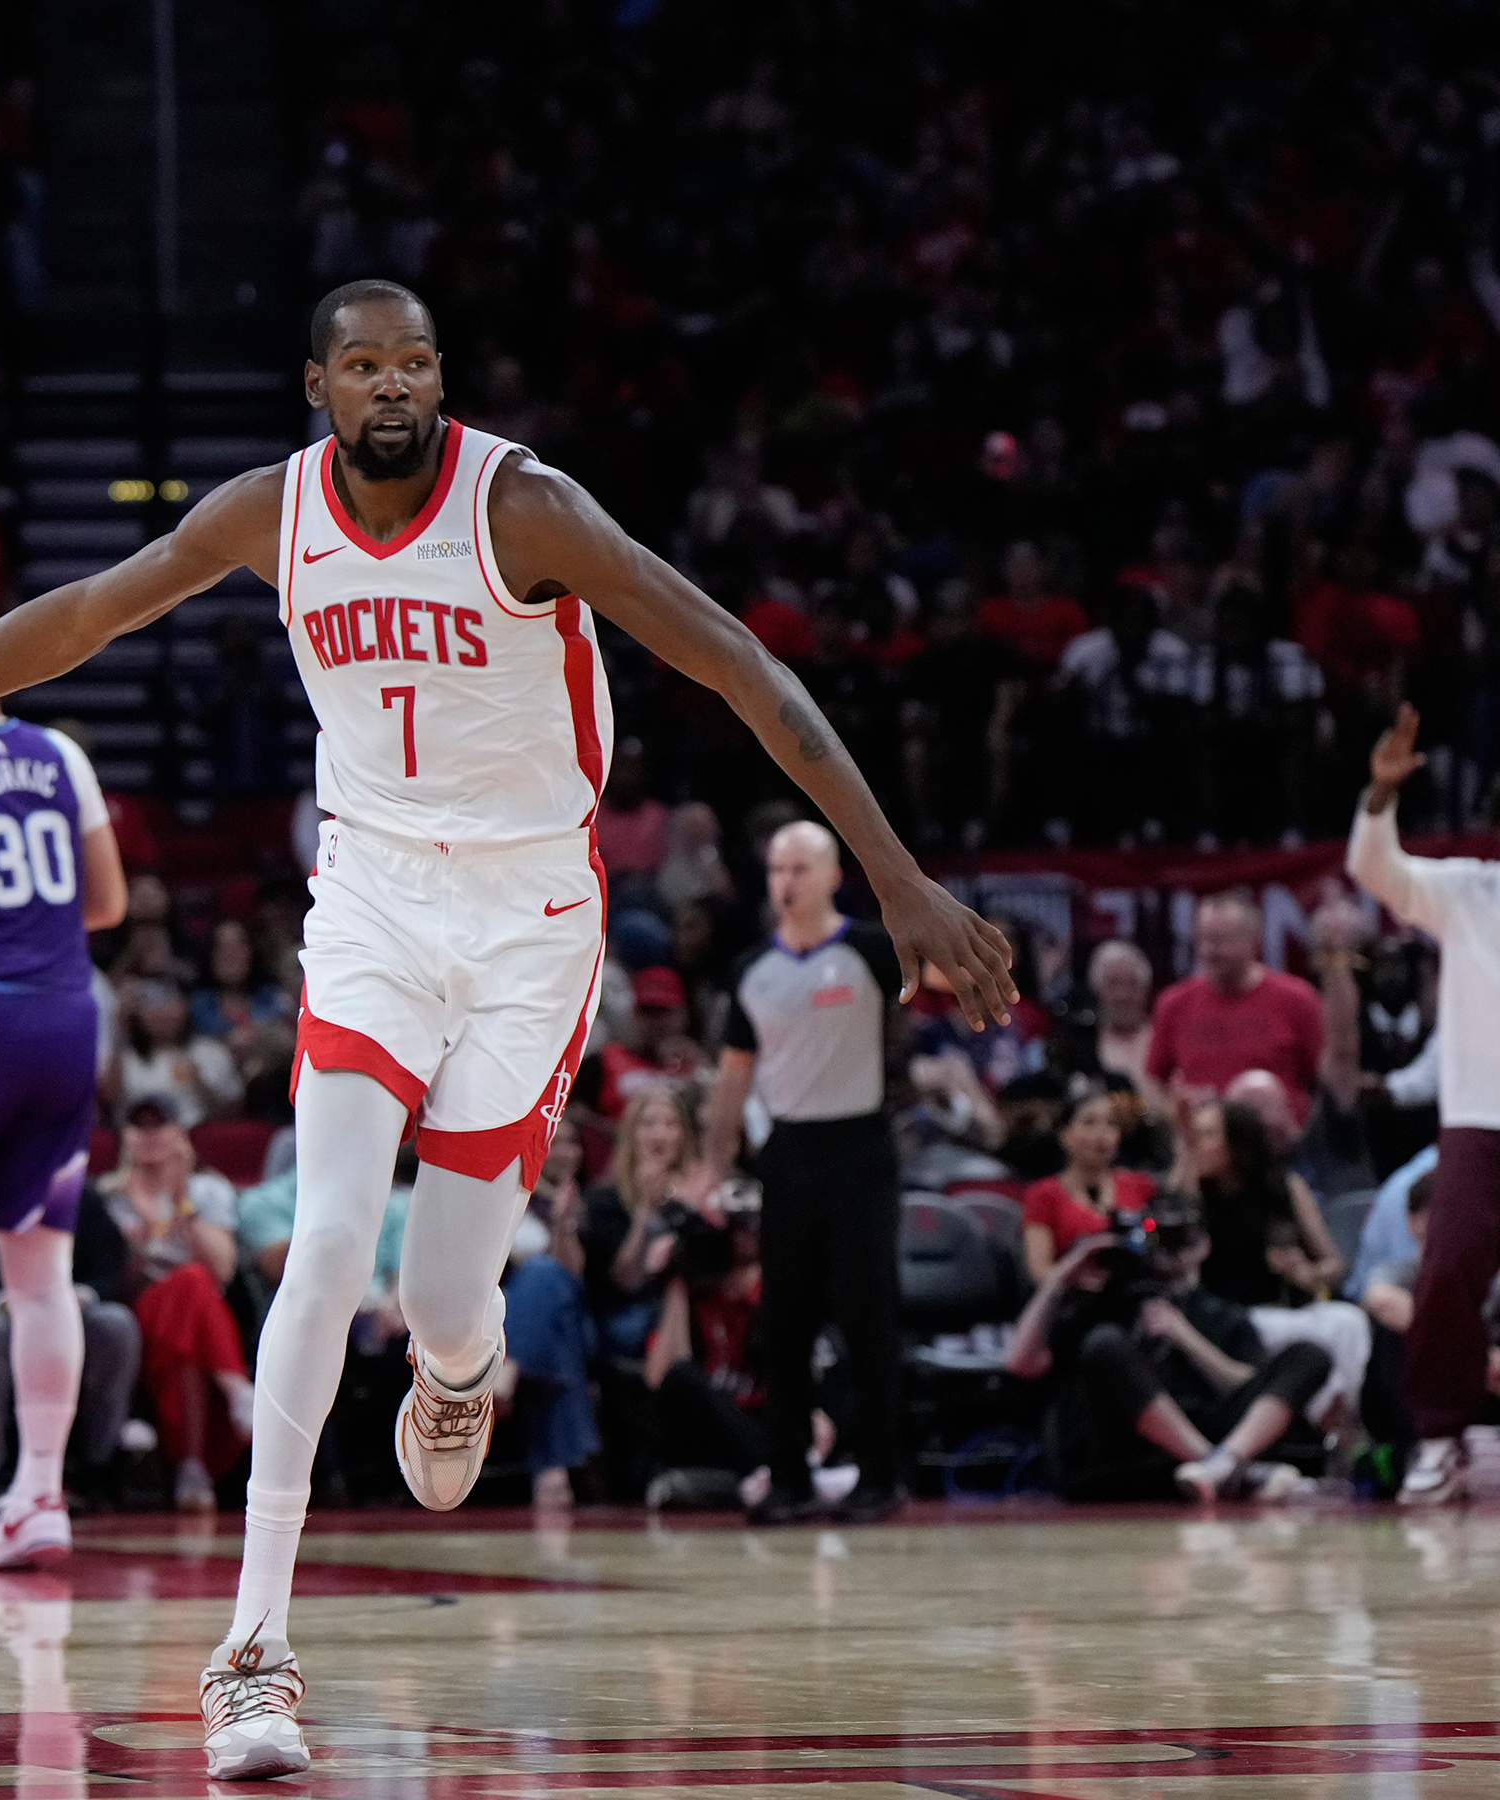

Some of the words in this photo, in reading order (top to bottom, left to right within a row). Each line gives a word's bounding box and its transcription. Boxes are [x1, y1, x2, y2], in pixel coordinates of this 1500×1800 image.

[417, 540, 472, 552] MEMORIAL
[417, 547, 472, 560] HERMANN
[303, 597, 488, 670] ROCKETS
[380, 686, 417, 778] 7
